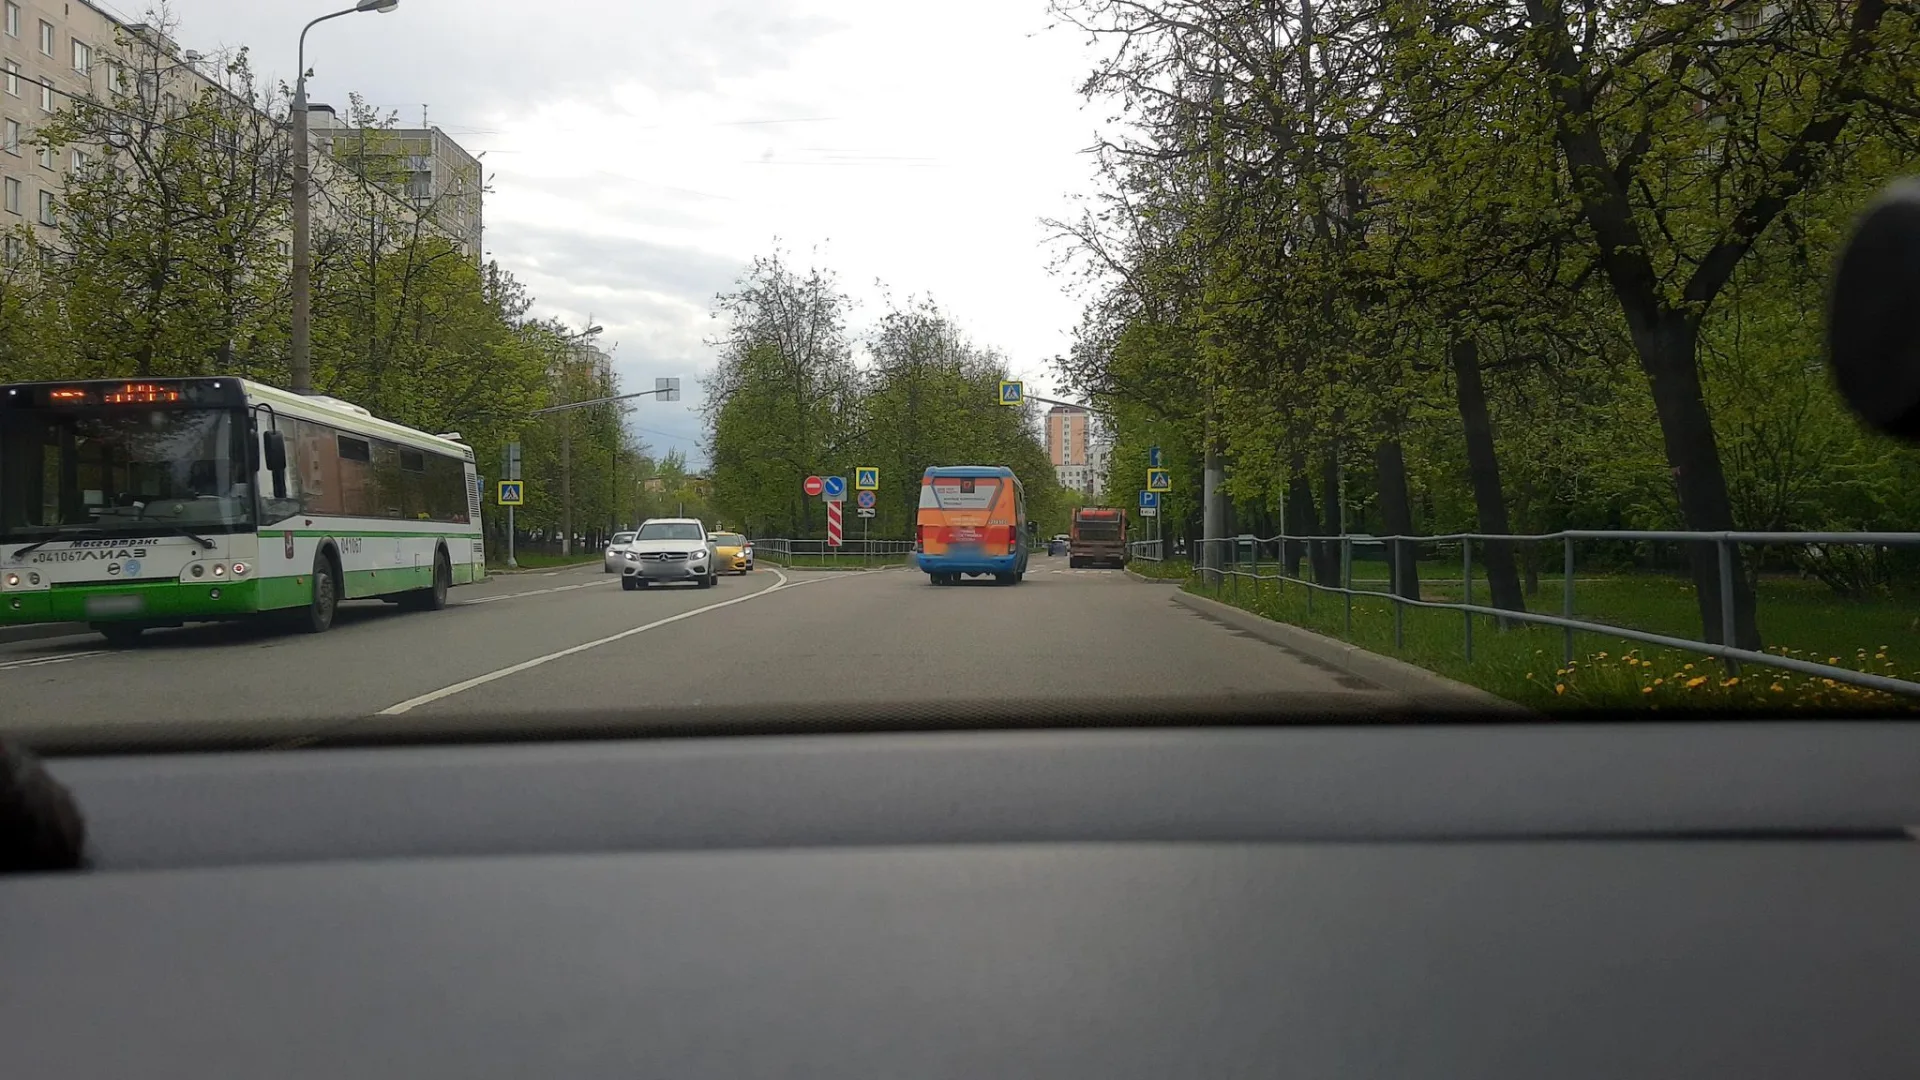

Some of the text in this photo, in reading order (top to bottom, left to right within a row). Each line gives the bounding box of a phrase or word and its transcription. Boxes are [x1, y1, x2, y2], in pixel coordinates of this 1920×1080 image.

[70, 538, 159, 548] Мосгортранс
[40, 552, 82, 563] 041067
[81, 549, 147, 560] ЛИАЗ
